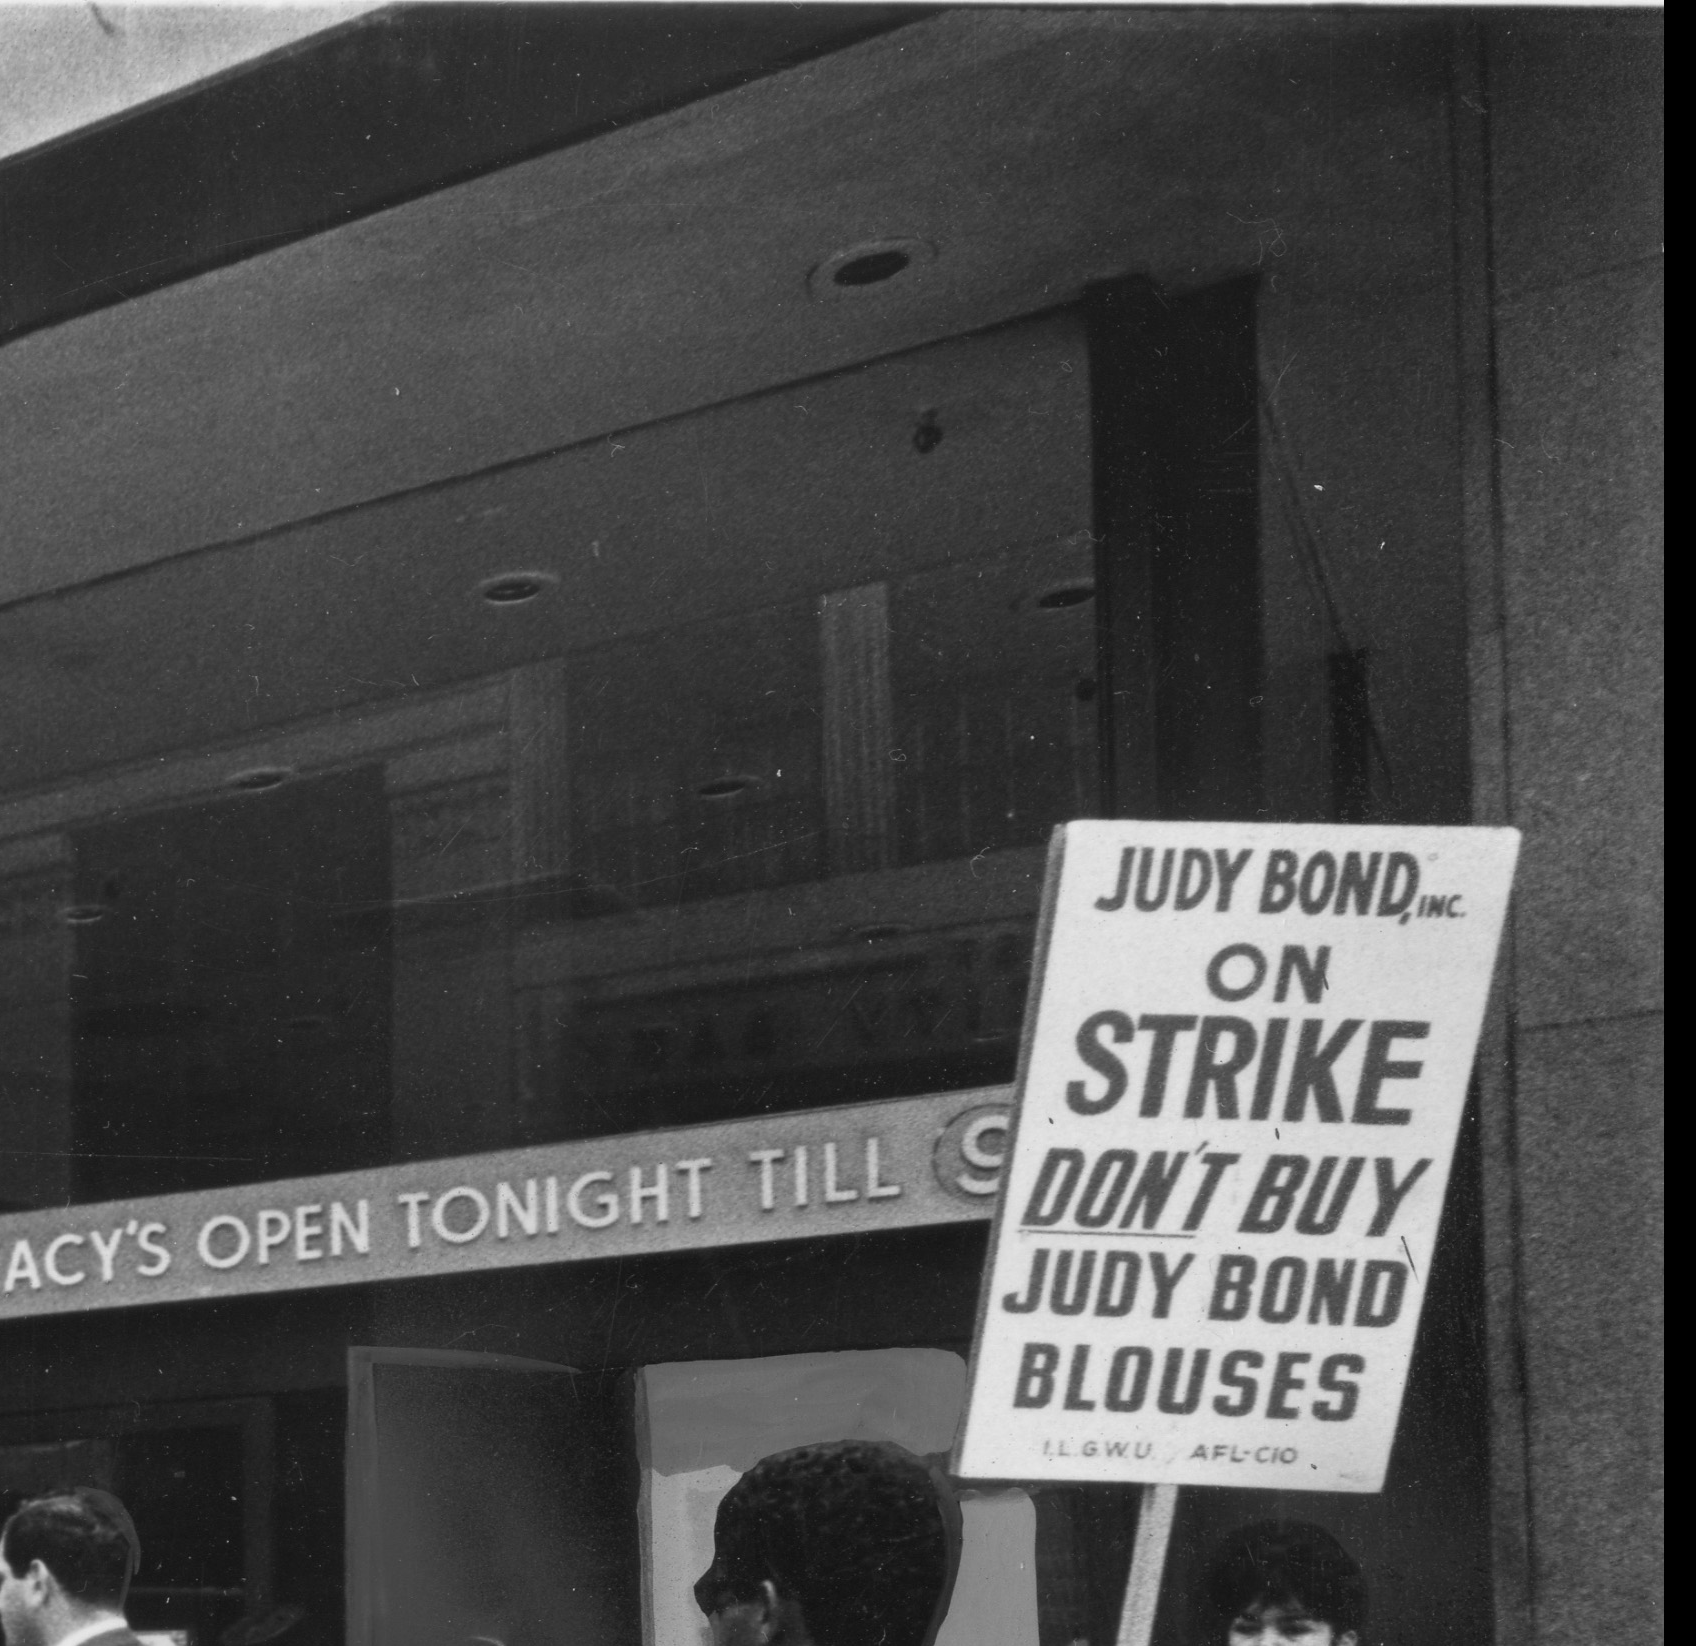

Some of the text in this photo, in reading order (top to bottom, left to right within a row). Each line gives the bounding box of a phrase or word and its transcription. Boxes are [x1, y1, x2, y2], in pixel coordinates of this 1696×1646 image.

[1094, 846, 1467, 926] JUDY BOND, INC.
[1206, 942, 1331, 1004] ON
[1065, 1009, 1432, 1126] STRIKE
[196, 1200, 370, 1269] OPEN
[397, 1155, 713, 1250] TONIGHT
[747, 1137, 901, 1211] TILL
[1020, 1141, 1433, 1237] DON'T BUY
[1001, 1248, 1408, 1328] JUDY BOND
[1012, 1342, 1366, 1422] BLOUSES
[1189, 1443, 1299, 1465] AFL-CIO
